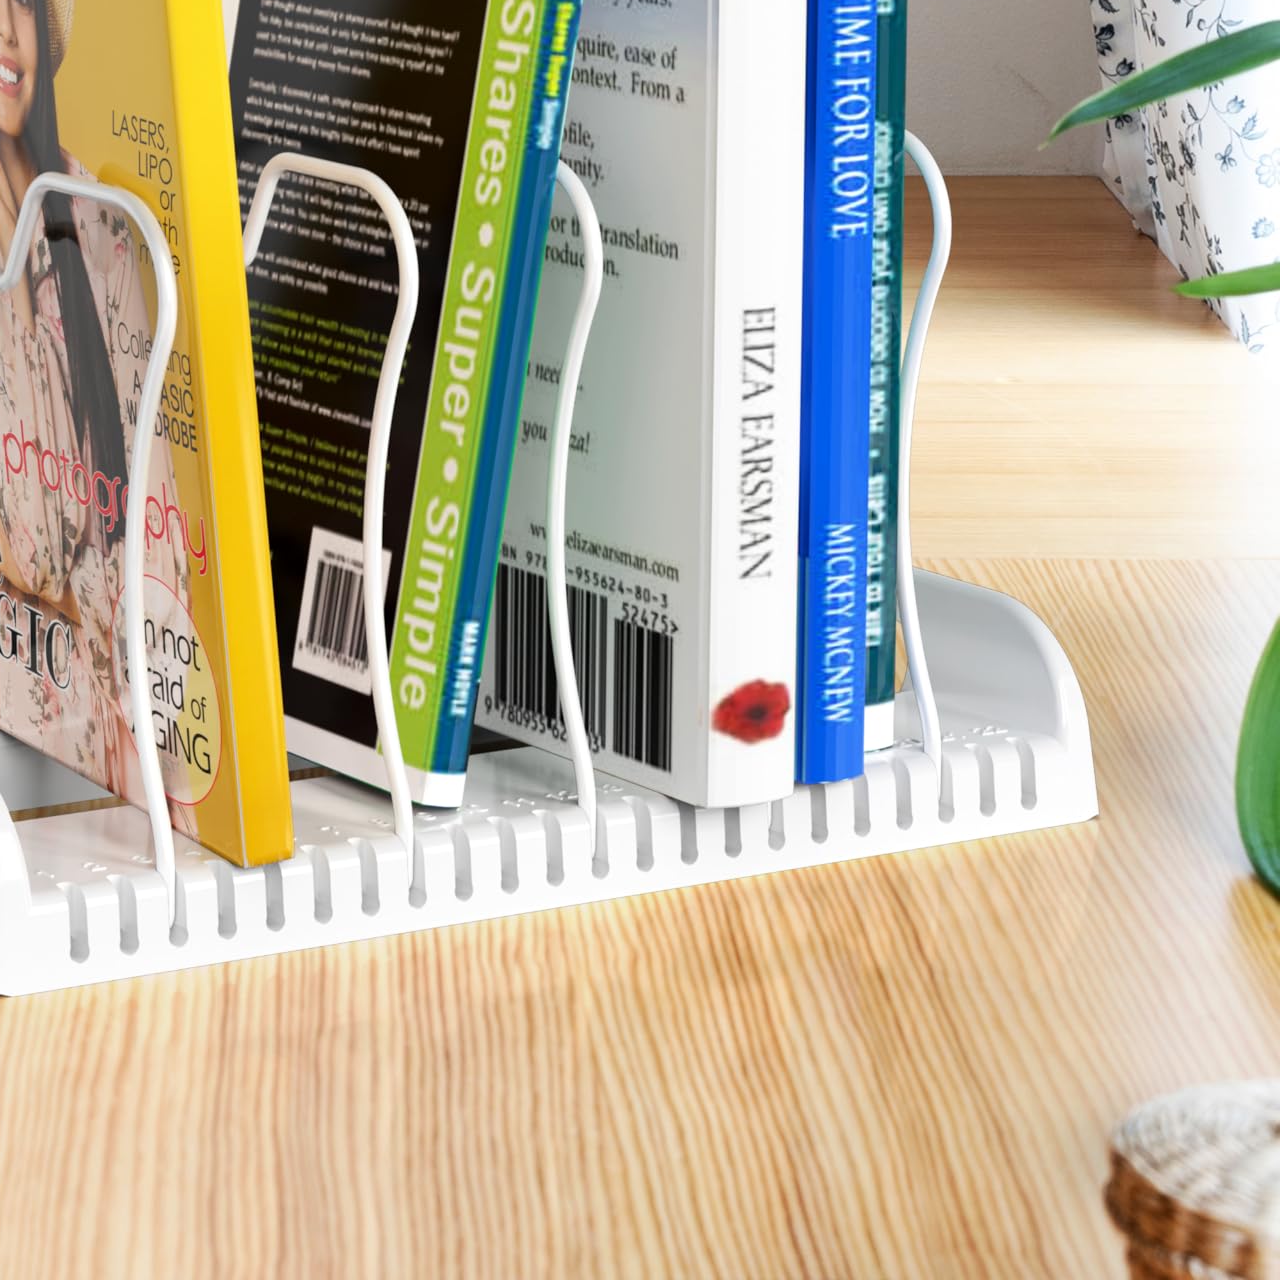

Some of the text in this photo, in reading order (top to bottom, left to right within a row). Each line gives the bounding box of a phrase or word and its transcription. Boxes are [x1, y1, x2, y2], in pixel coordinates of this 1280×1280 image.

[624, 45, 677, 71] ease of
[631, 72, 671, 102] From
[675, 86, 685, 103] a
[832, 75, 871, 147] FOR
[111, 109, 170, 154] LASERS,
[137, 149, 173, 185] LIPO
[159, 189, 177, 213] or
[829, 153, 870, 240] LOVE
[439, 261, 495, 448] Super
[738, 306, 776, 582] ELIZA EARSMAN
[822, 522, 858, 620] MICKEY
[399, 495, 461, 712] Simple
[161, 624, 201, 672] not
[190, 696, 207, 724] of
